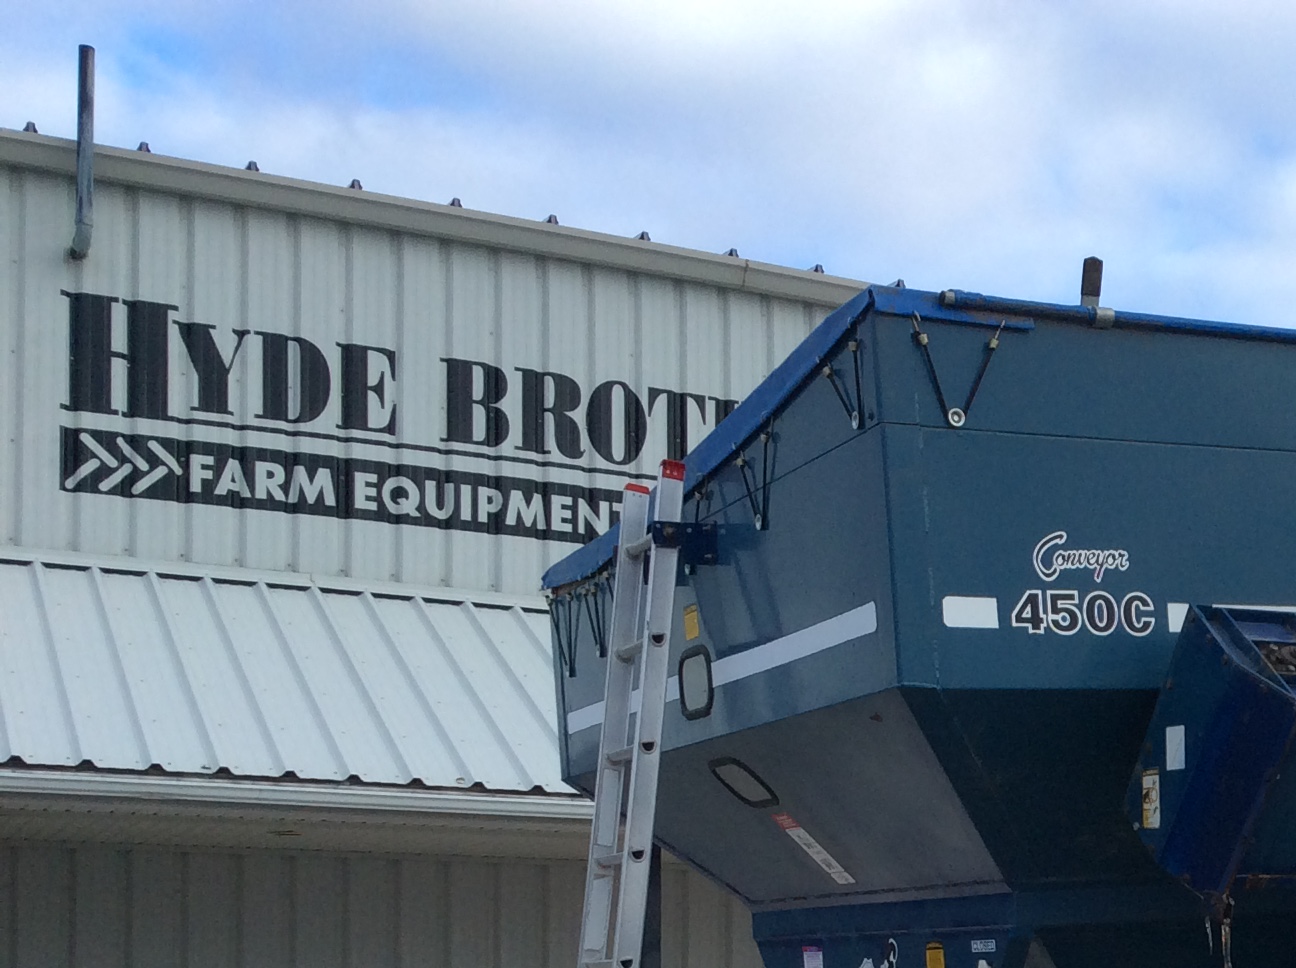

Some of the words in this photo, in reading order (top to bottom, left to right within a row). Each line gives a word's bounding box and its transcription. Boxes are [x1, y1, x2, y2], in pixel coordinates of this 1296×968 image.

[60, 289, 397, 436] HYDE
[440, 357, 740, 466] BROT
[189, 453, 336, 507] FARM
[1033, 531, 1129, 582] Conveyor
[1012, 590, 1155, 636] 450C
